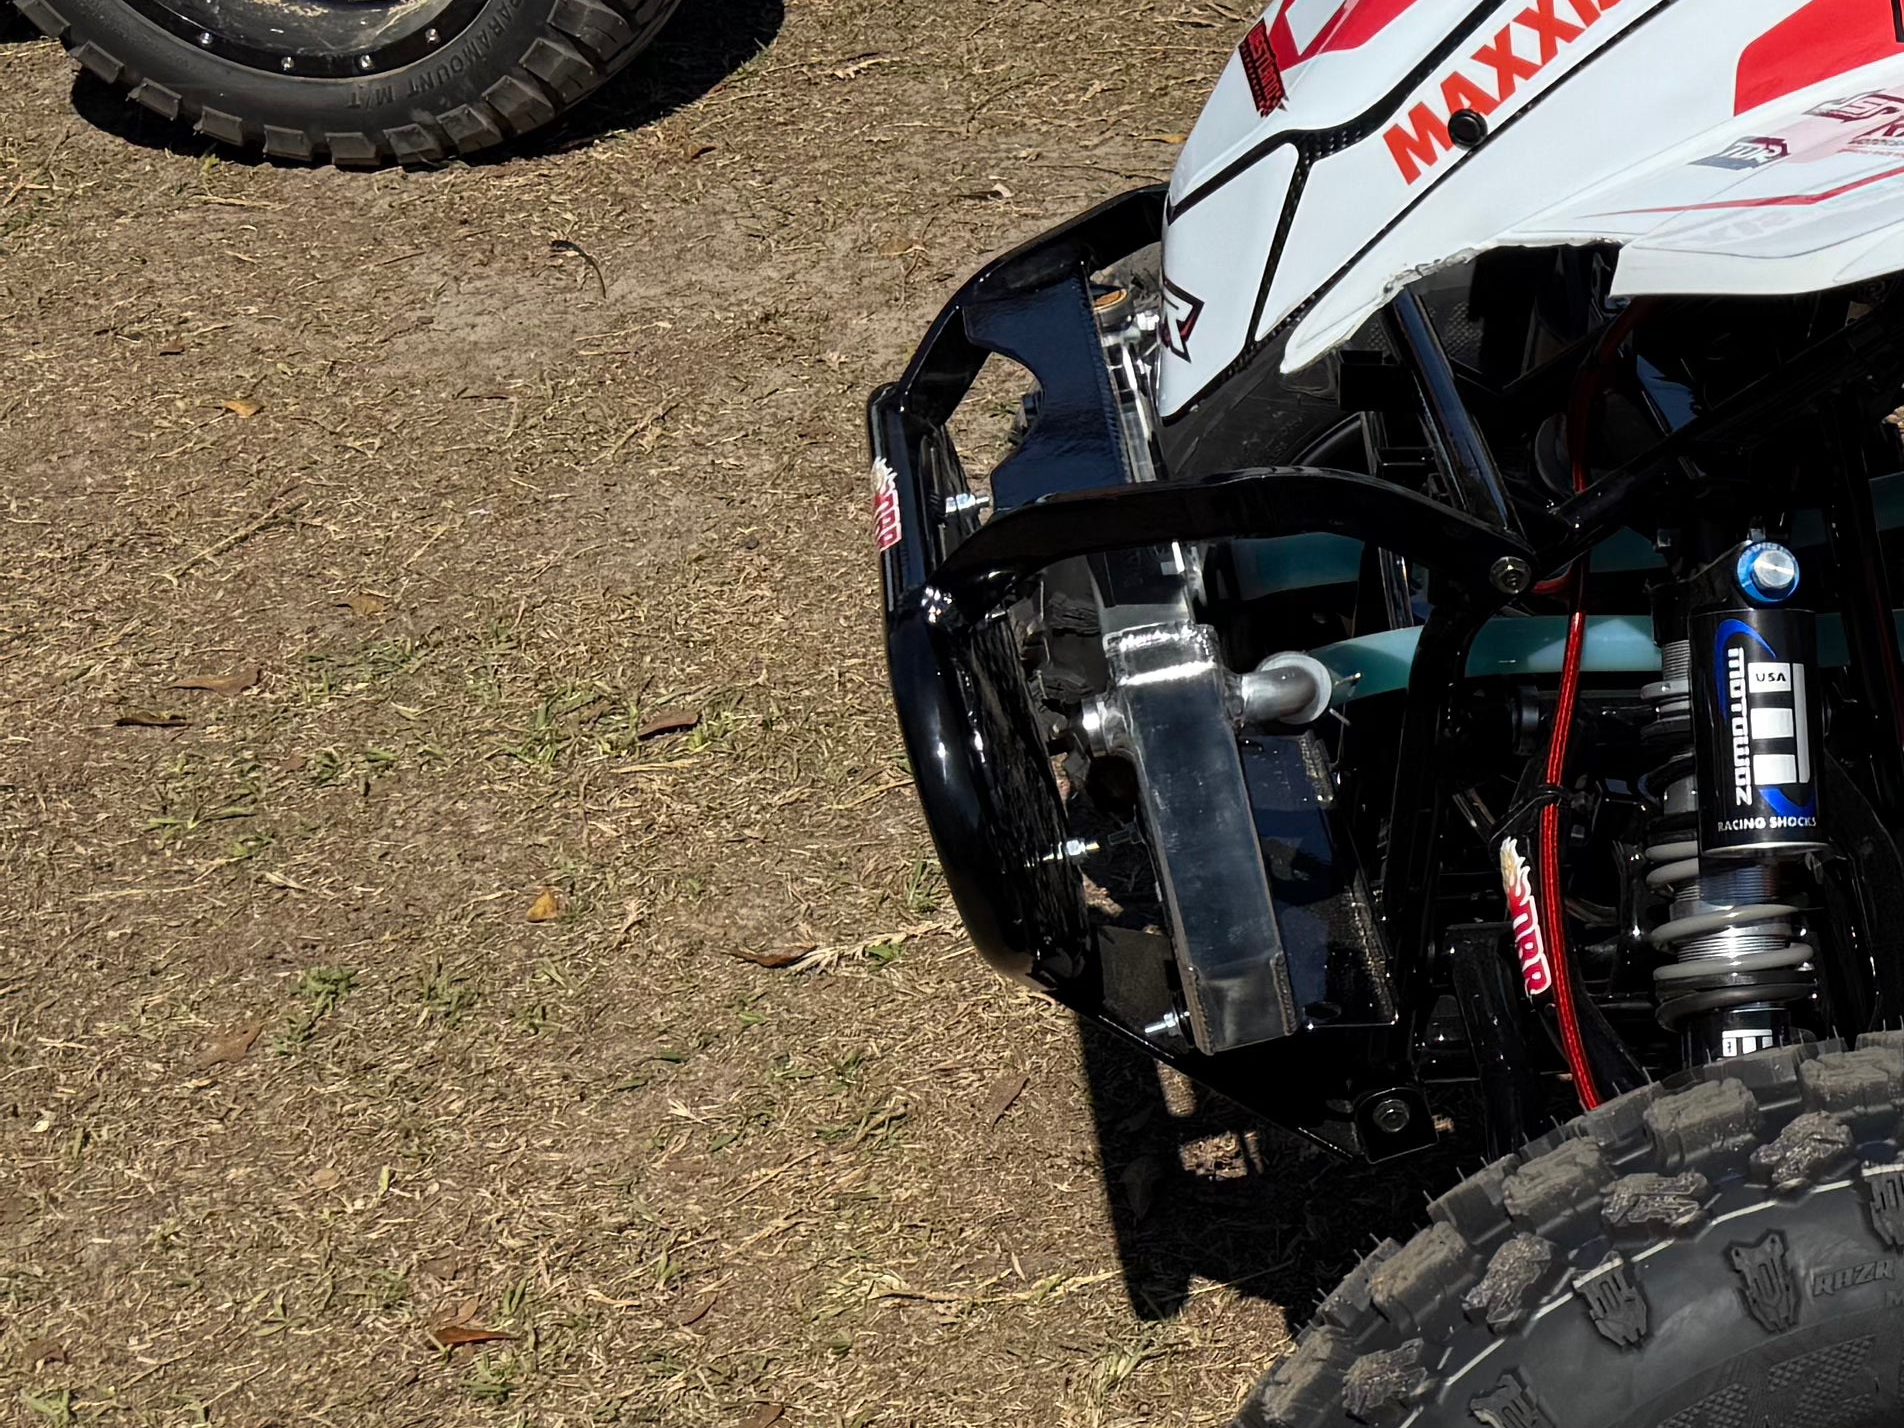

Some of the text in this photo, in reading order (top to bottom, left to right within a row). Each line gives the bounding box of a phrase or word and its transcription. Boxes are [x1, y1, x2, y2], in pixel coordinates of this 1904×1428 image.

[1755, 672, 1788, 683] USA
[1718, 815, 1817, 833] RACING SHOCKS
[1811, 1258, 1897, 1297] RAZR
